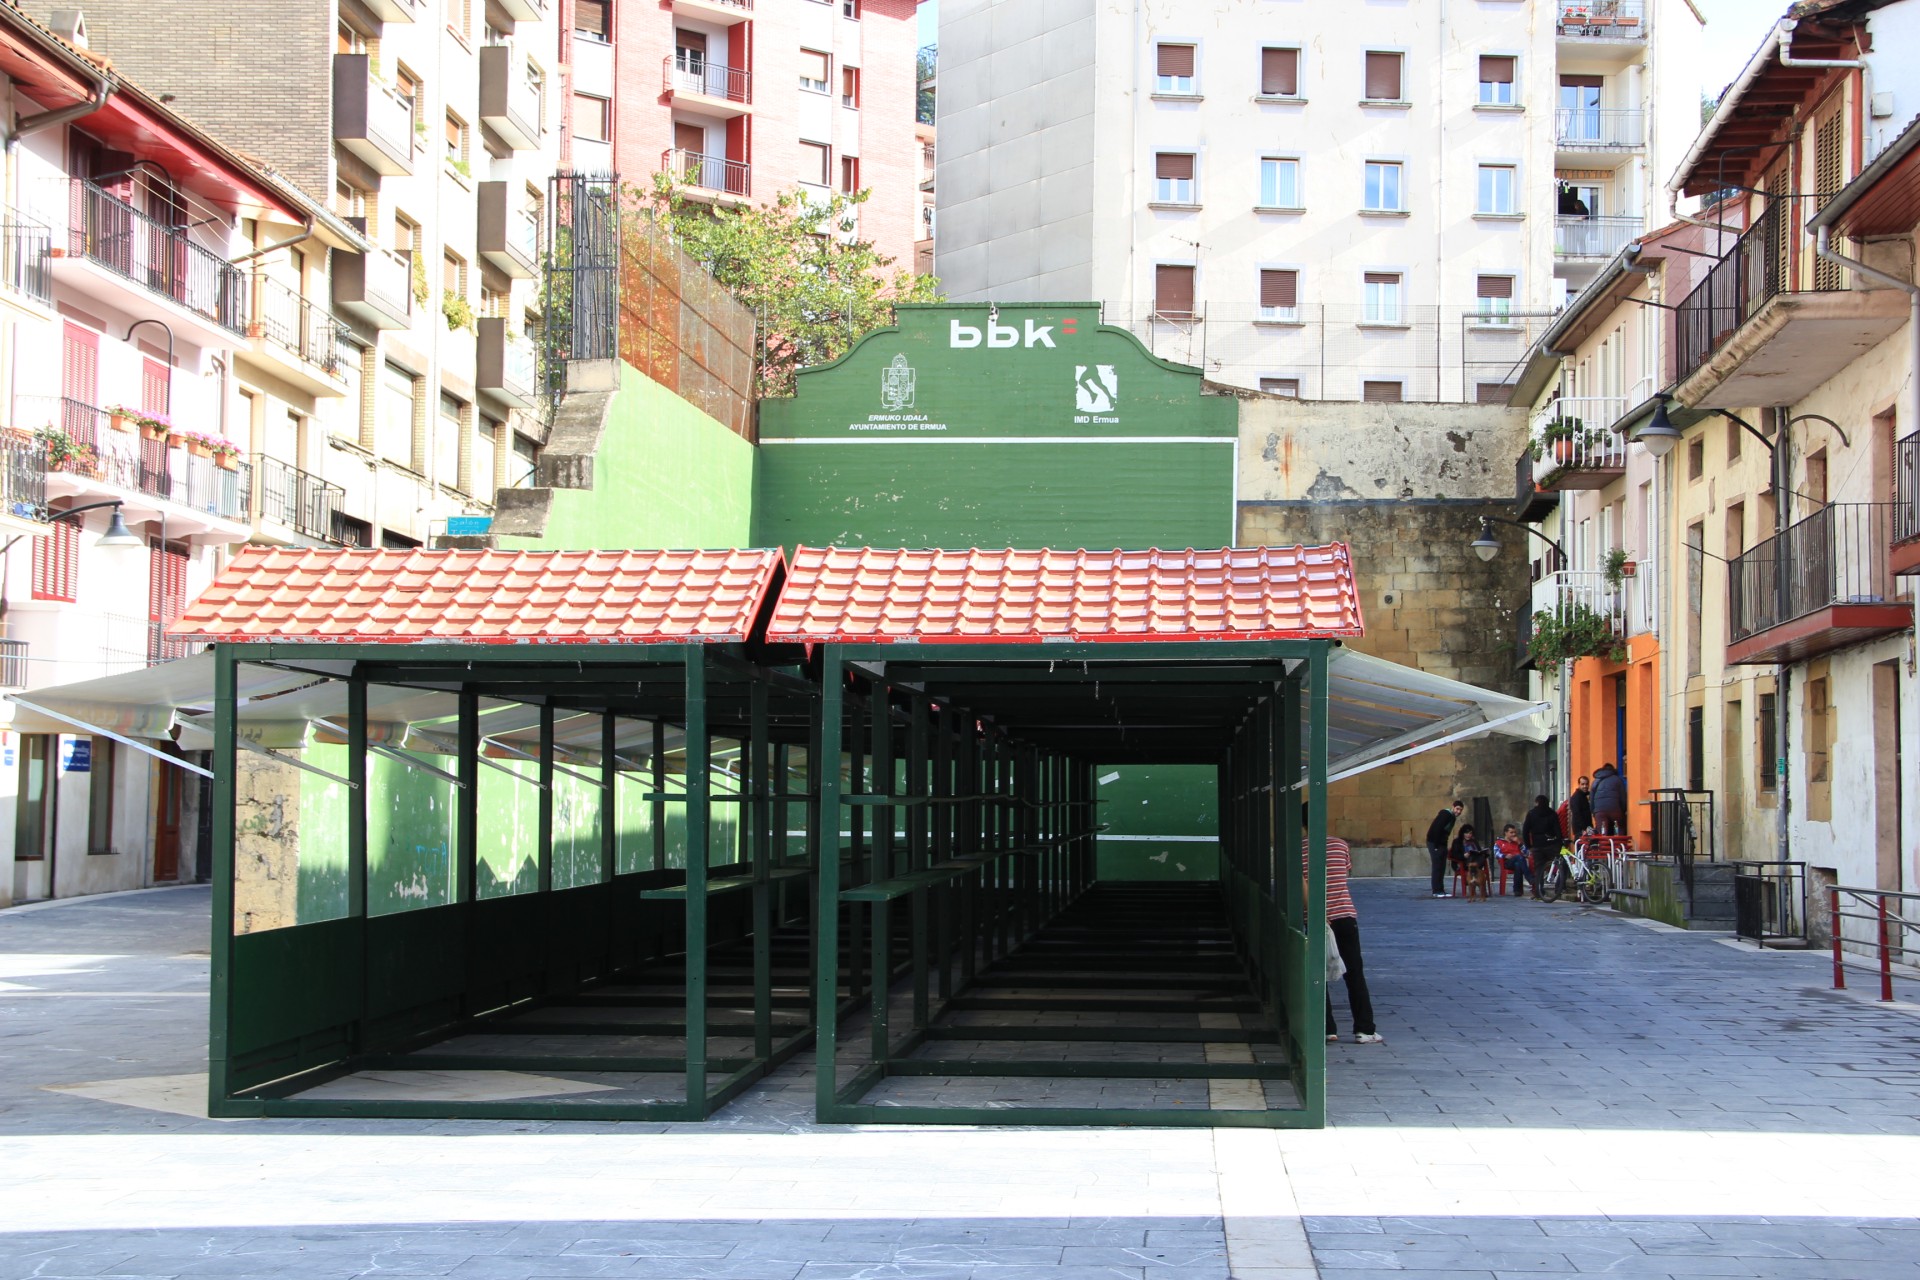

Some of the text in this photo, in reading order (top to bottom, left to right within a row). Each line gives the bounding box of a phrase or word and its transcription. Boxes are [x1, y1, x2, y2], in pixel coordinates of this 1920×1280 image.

[950, 319, 1057, 348] bbk
[1074, 415, 1120, 424] IMD Ermua
